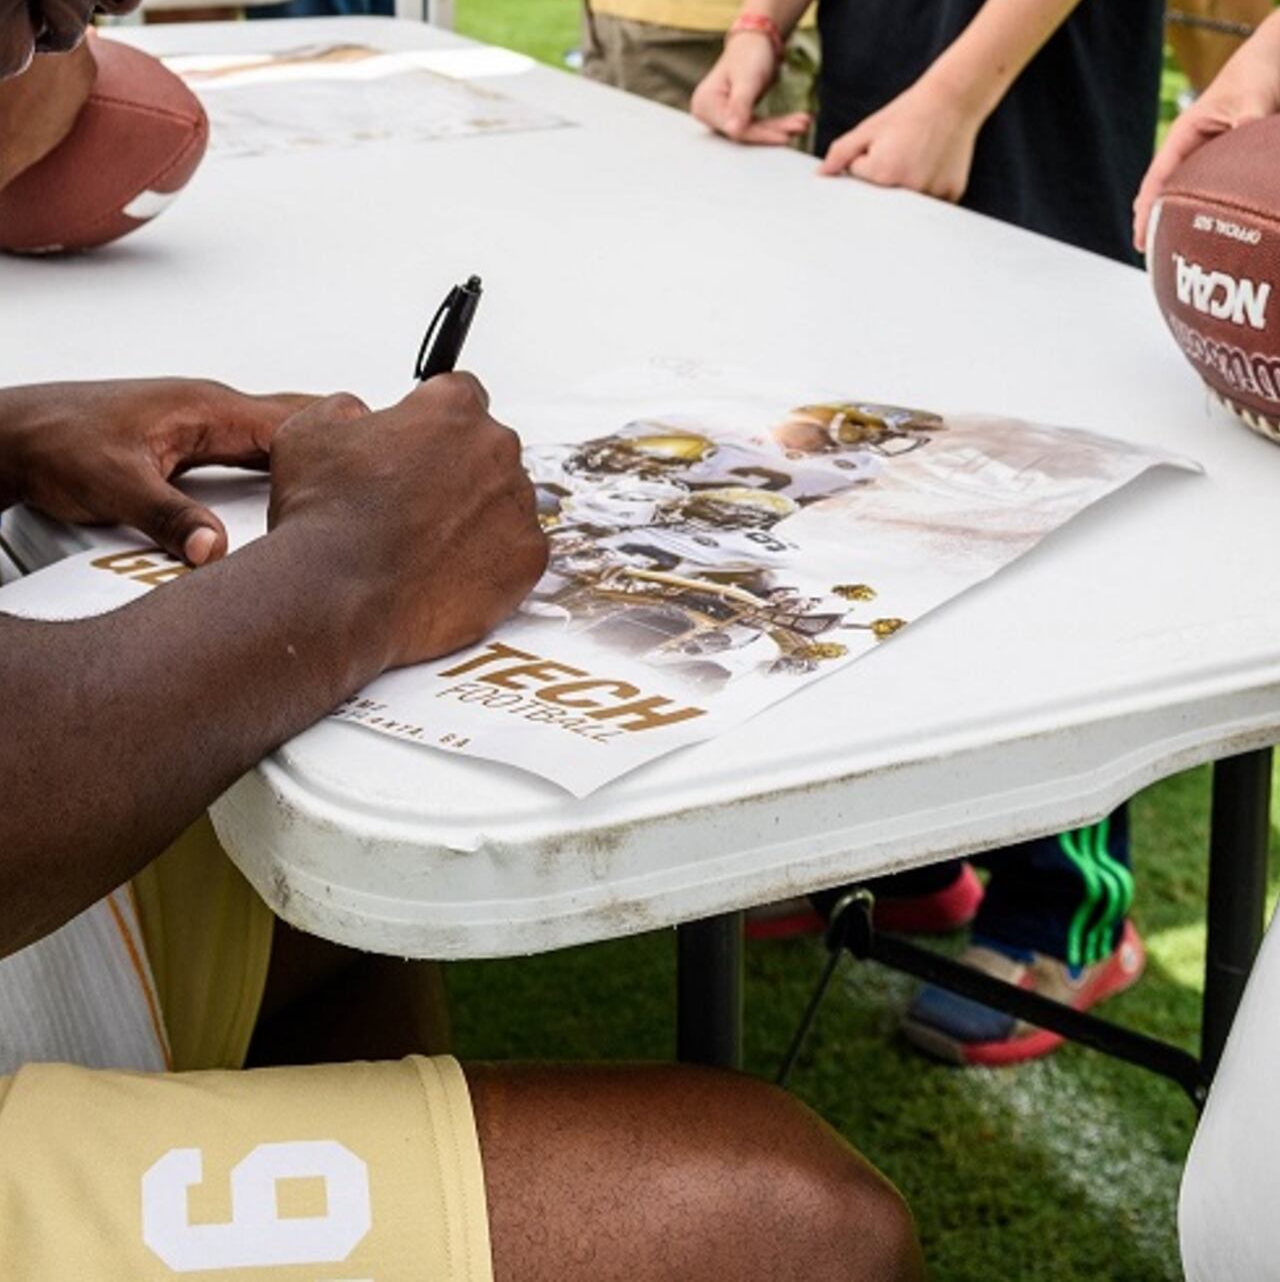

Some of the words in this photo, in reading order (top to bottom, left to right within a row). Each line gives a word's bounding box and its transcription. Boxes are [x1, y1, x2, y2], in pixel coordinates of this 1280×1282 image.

[1172, 253, 1271, 331] NCAA
[434, 681, 624, 744] FOOTBALL
[436, 641, 708, 733] TECH
[140, 1138, 374, 1282] 6
